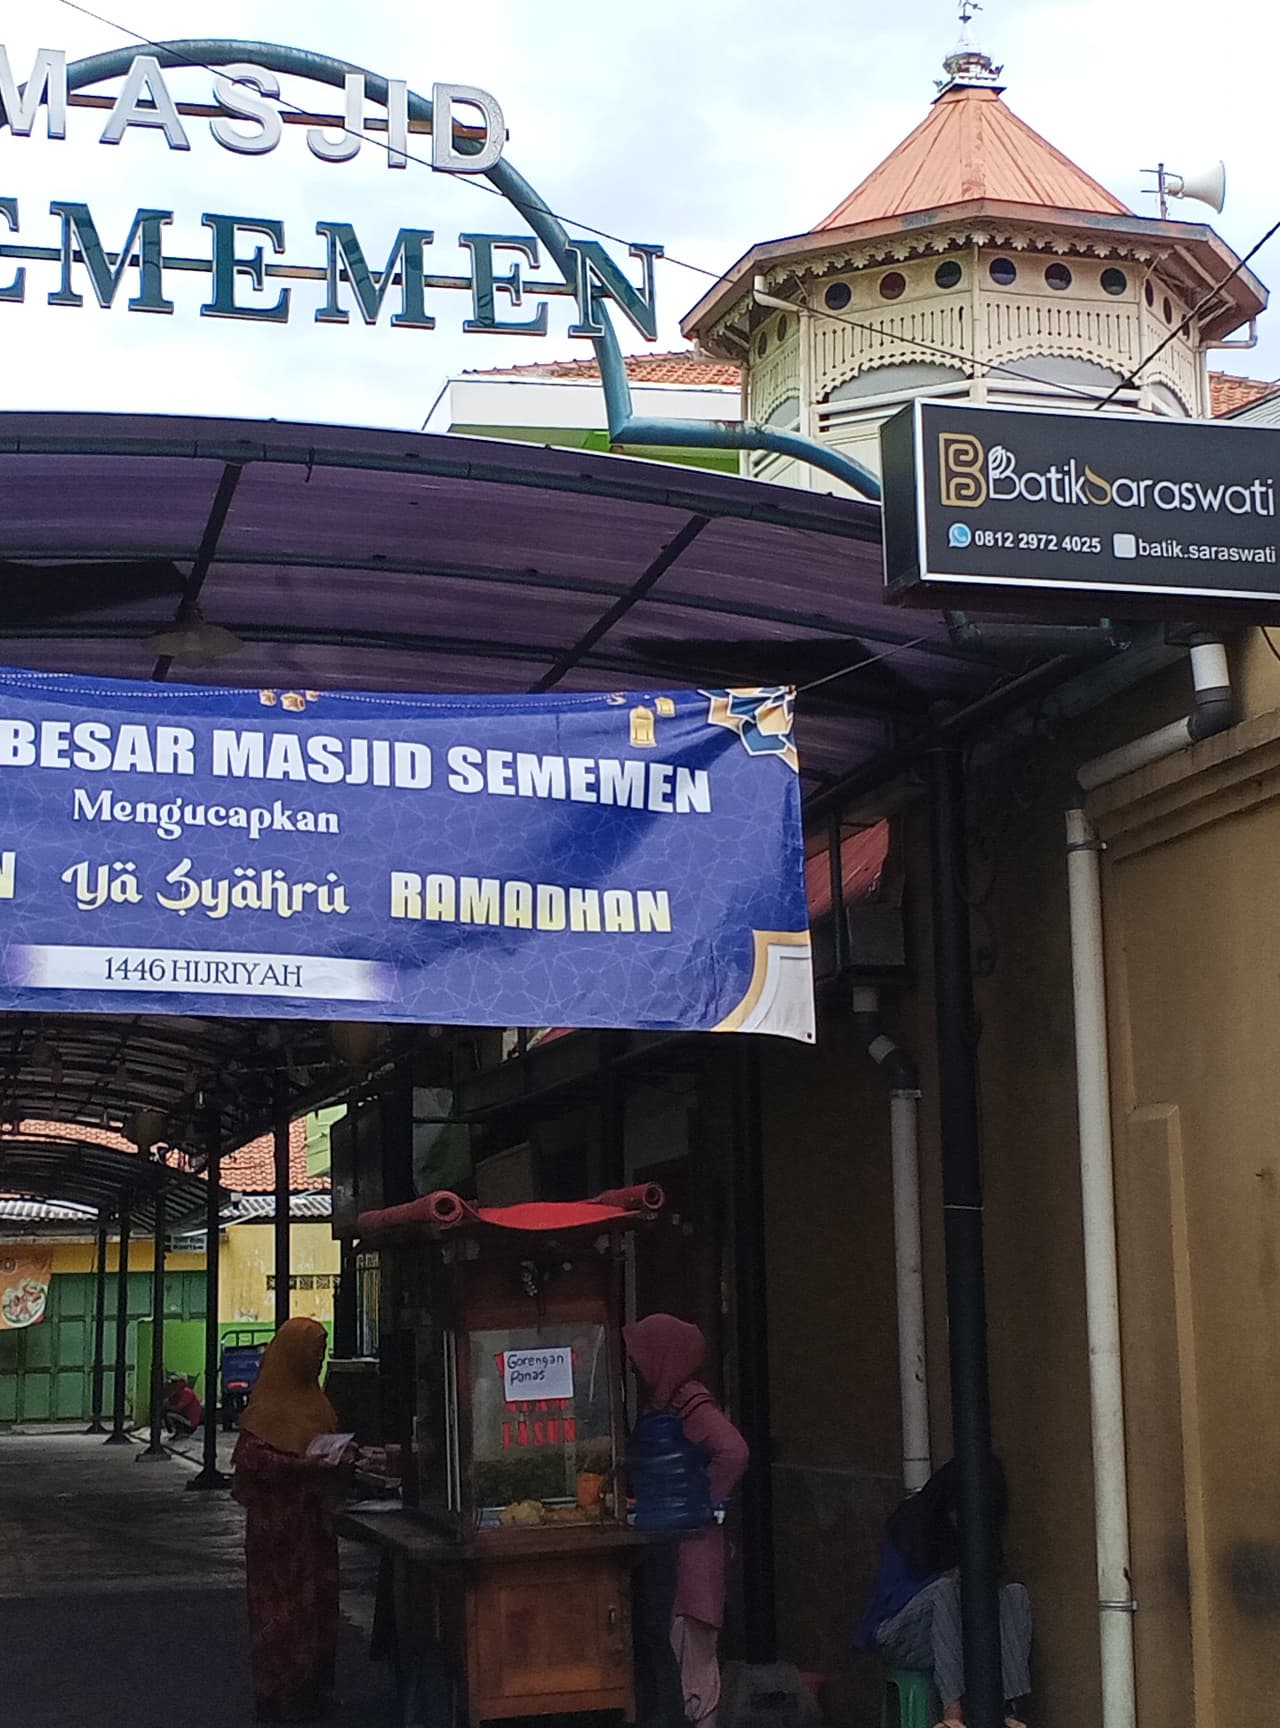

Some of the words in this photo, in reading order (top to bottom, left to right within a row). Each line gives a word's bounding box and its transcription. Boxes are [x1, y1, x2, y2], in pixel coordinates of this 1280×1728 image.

[974, 530, 1014, 548] 0812
[1018, 532, 1058, 551] 2972
[1061, 535, 1102, 553] 4025
[1138, 537, 1277, 564] batik.saraswati
[212, 729, 433, 791] MASJID
[447, 745, 712, 815] SEMEMEN
[72, 788, 340, 840] Mengucapkan
[390, 871, 672, 933] RAMADHAN
[104, 956, 166, 982] 1446
[170, 959, 303, 988] HIJRIYAH
[507, 1353, 565, 1370] Gorengan
[510, 1369, 546, 1387] Panas
